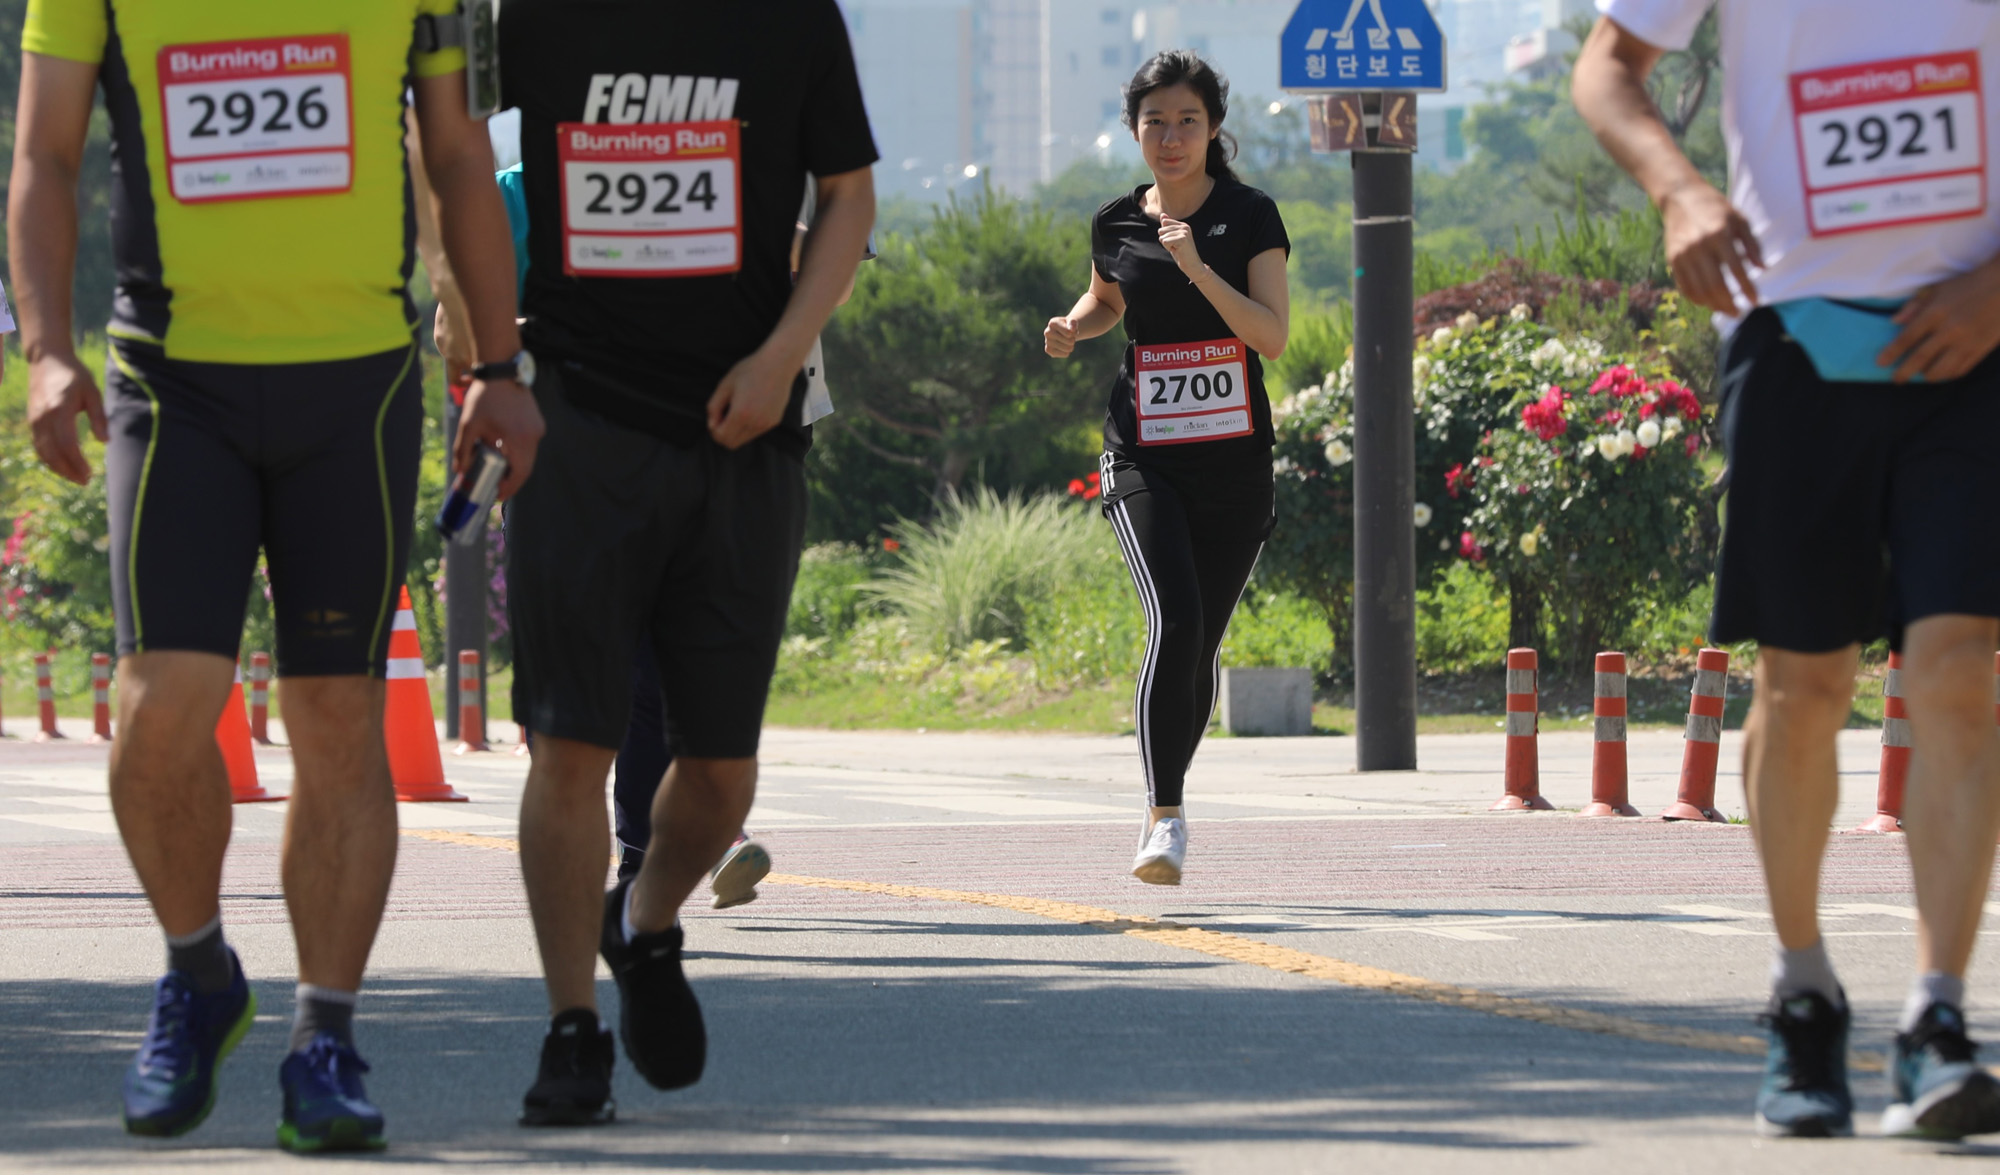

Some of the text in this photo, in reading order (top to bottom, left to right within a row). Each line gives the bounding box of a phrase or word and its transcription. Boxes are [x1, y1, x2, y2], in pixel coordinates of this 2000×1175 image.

[170, 47, 278, 73] Burning
[283, 44, 337, 64] Run
[1305, 54, 1423, 79] 횡단보도
[582, 73, 740, 125] FCMM
[1800, 62, 1970, 101] Burning Run
[187, 86, 330, 139] 2926
[570, 130, 727, 155] Burning Run
[1820, 106, 1956, 168] 2921
[584, 170, 718, 216] 2924
[1206, 223, 1228, 237] NB
[1142, 345, 1237, 363] Burning Run
[1149, 370, 1233, 405] 2700
